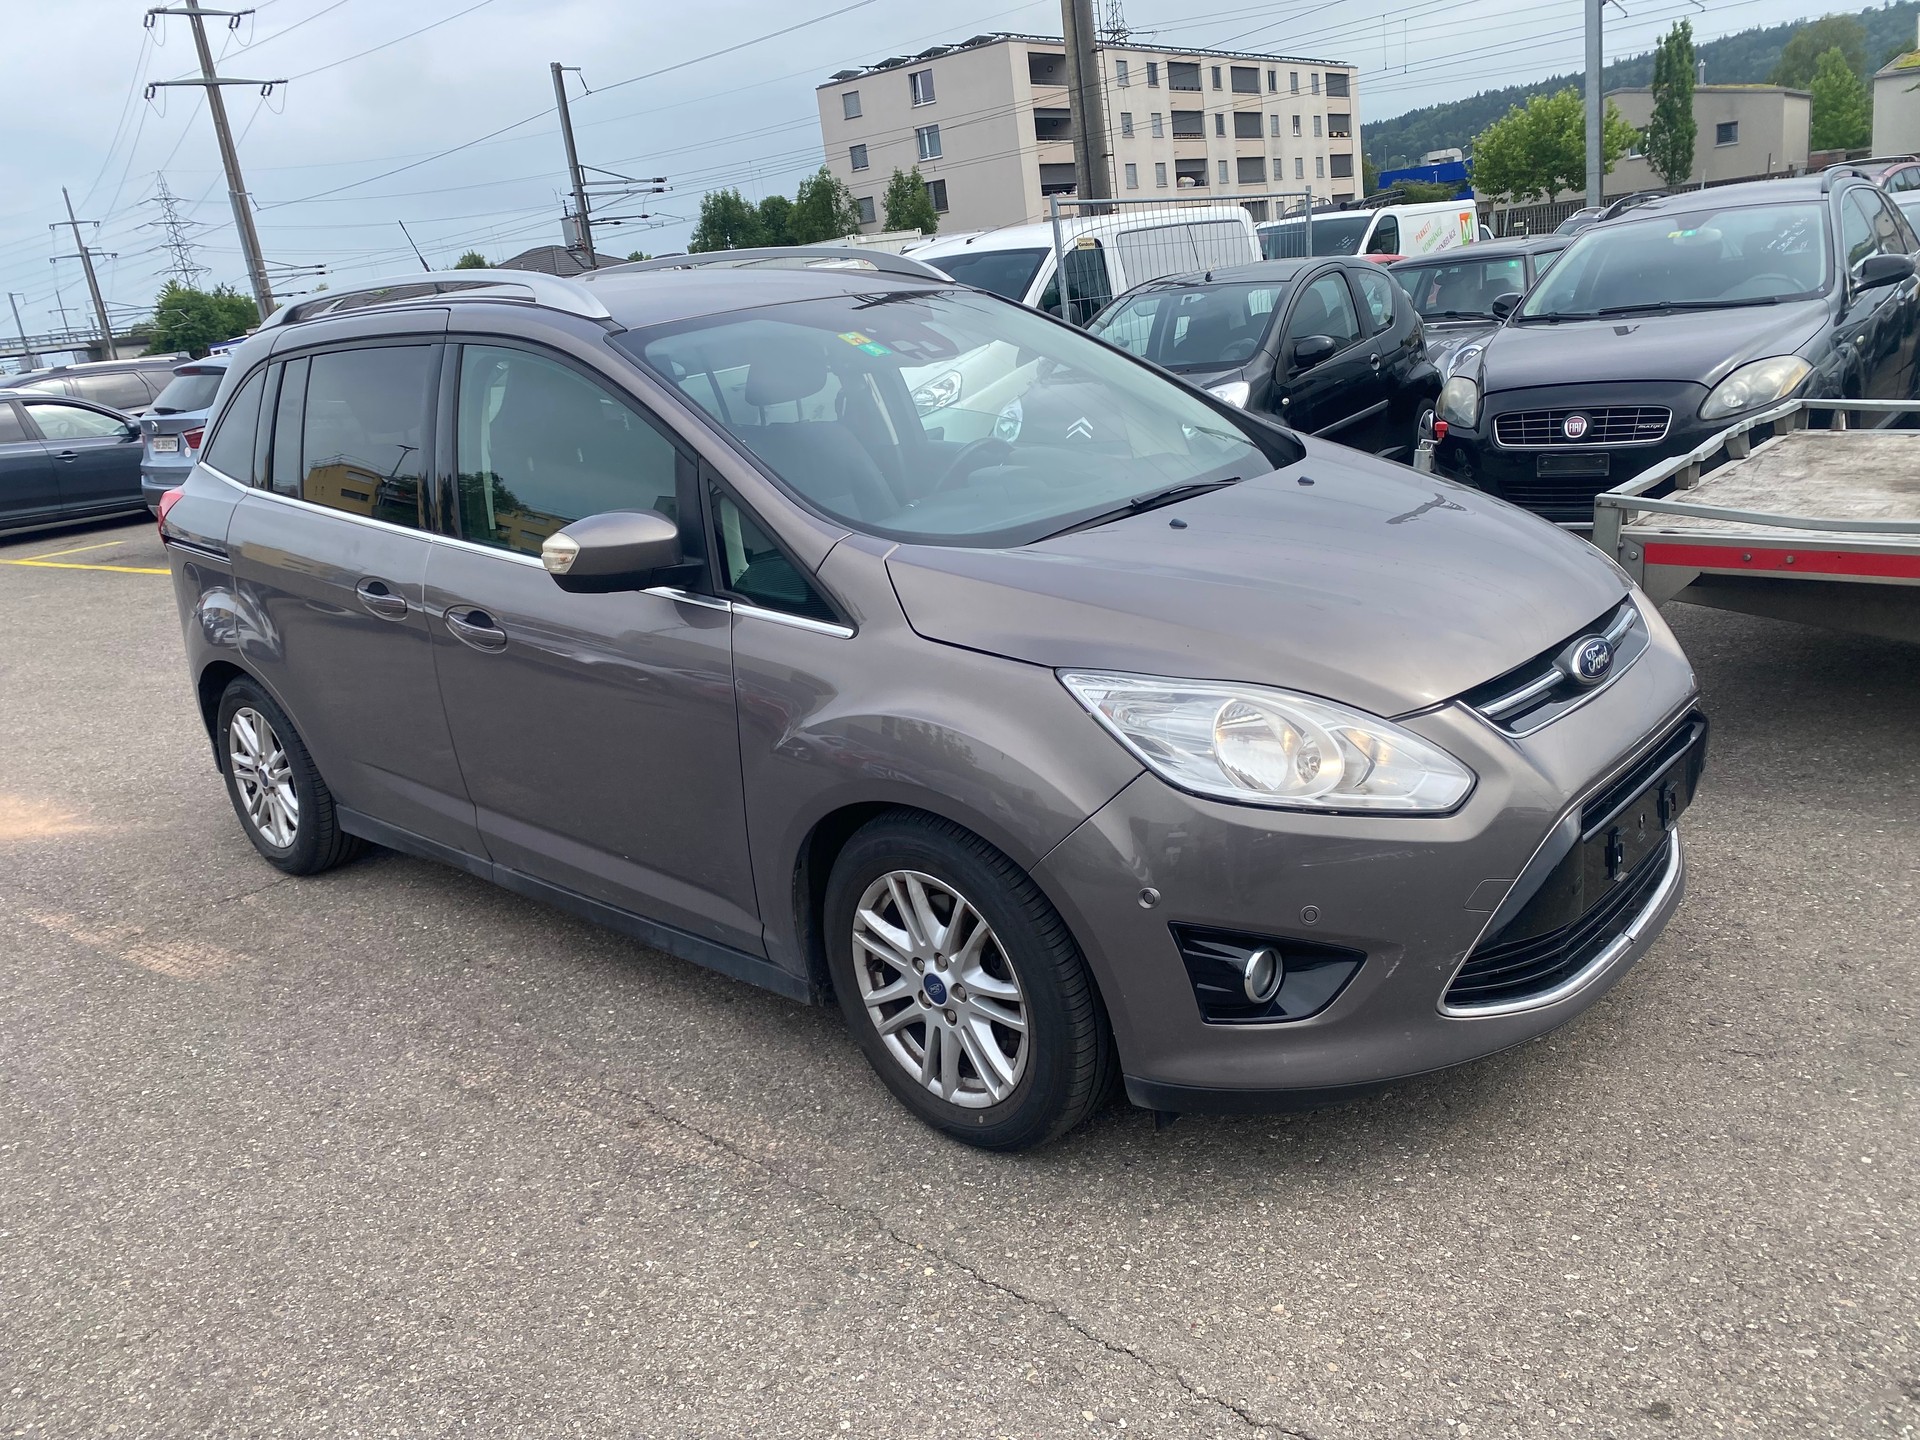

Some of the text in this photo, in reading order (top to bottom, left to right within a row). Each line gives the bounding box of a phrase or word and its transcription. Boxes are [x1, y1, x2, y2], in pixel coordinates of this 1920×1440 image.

[1415, 220, 1432, 243] PARKETT
[1569, 422, 1582, 433] FIAT
[1585, 644, 1608, 672] Ford
